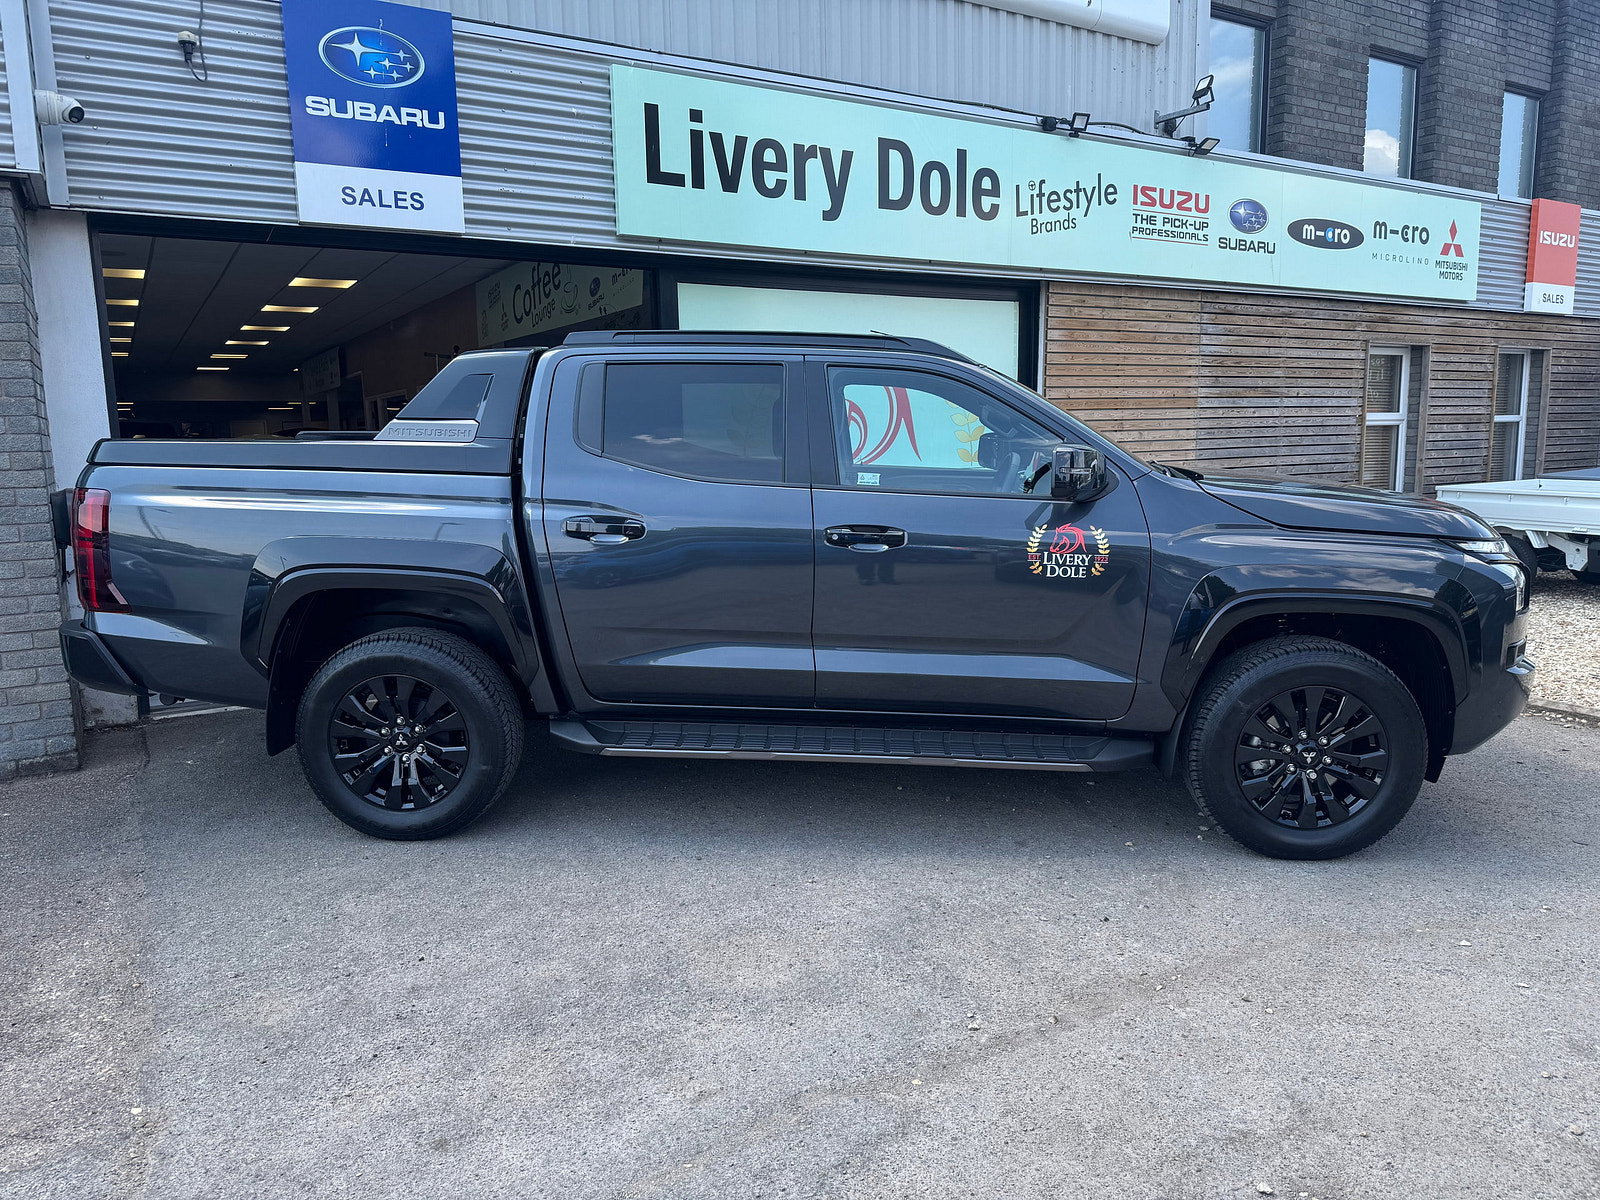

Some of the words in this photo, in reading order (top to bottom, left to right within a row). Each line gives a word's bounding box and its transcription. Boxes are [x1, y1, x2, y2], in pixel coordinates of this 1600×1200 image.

[305, 95, 446, 130] SUBARU
[643, 102, 854, 222] Livery
[877, 136, 1001, 222] Dole
[341, 186, 425, 211] SALES
[1015, 172, 1118, 218] Lifestyle
[1132, 184, 1210, 214] ISUZU
[1030, 212, 1077, 235] Brands
[1132, 213, 1157, 226] THE
[1163, 216, 1209, 232] PICK-UP
[1132, 227, 1209, 242] PROFESSIONALS
[1539, 230, 1575, 248] ISUZU
[1218, 236, 1276, 254] SUBARU
[1372, 253, 1430, 266] MICROLINO
[1434, 260, 1468, 272] MITSUBISHI
[1438, 270, 1463, 281] MOTORS
[512, 262, 561, 324] Coffee
[1542, 292, 1564, 305] SALES
[531, 298, 556, 328] Lounge
[388, 427, 472, 438] MITSUBISHI
[1043, 551, 1092, 566] LIVERY
[1046, 564, 1087, 578] DOLE
